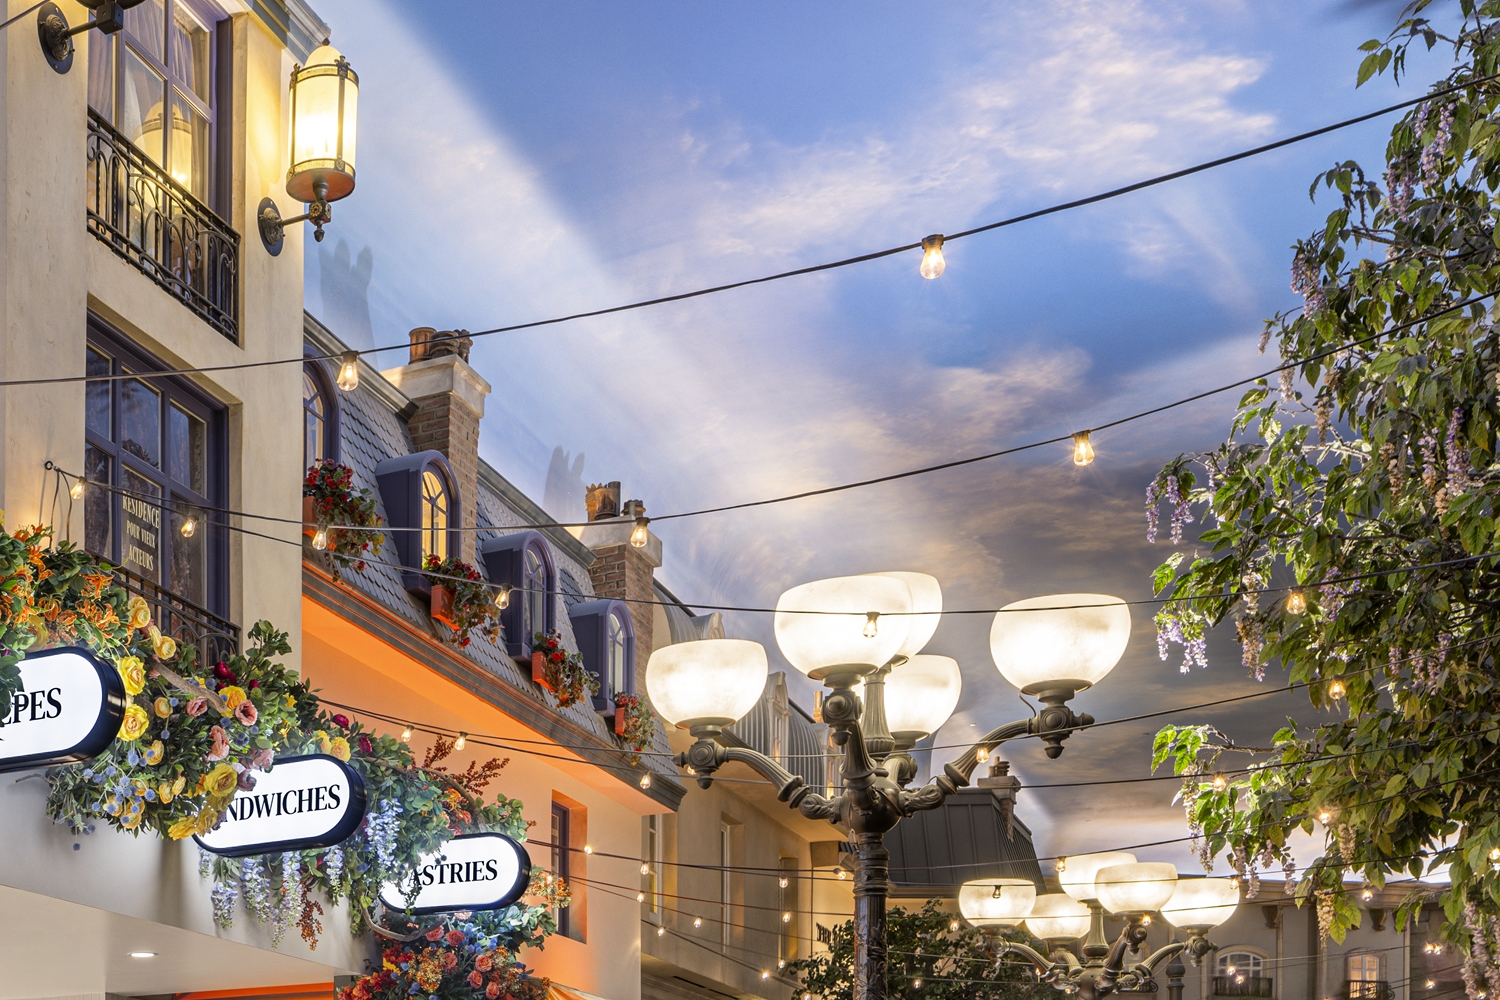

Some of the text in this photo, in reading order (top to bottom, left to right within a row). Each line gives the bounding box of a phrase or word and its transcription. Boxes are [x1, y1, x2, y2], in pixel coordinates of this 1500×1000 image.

[122, 490, 160, 528] RÉSIDENCE
[126, 519, 156, 549] POUR VIEUX
[128, 543, 154, 572] ACTEURS
[223, 784, 341, 822] NDWICHES
[407, 858, 498, 886] ASTRIES
